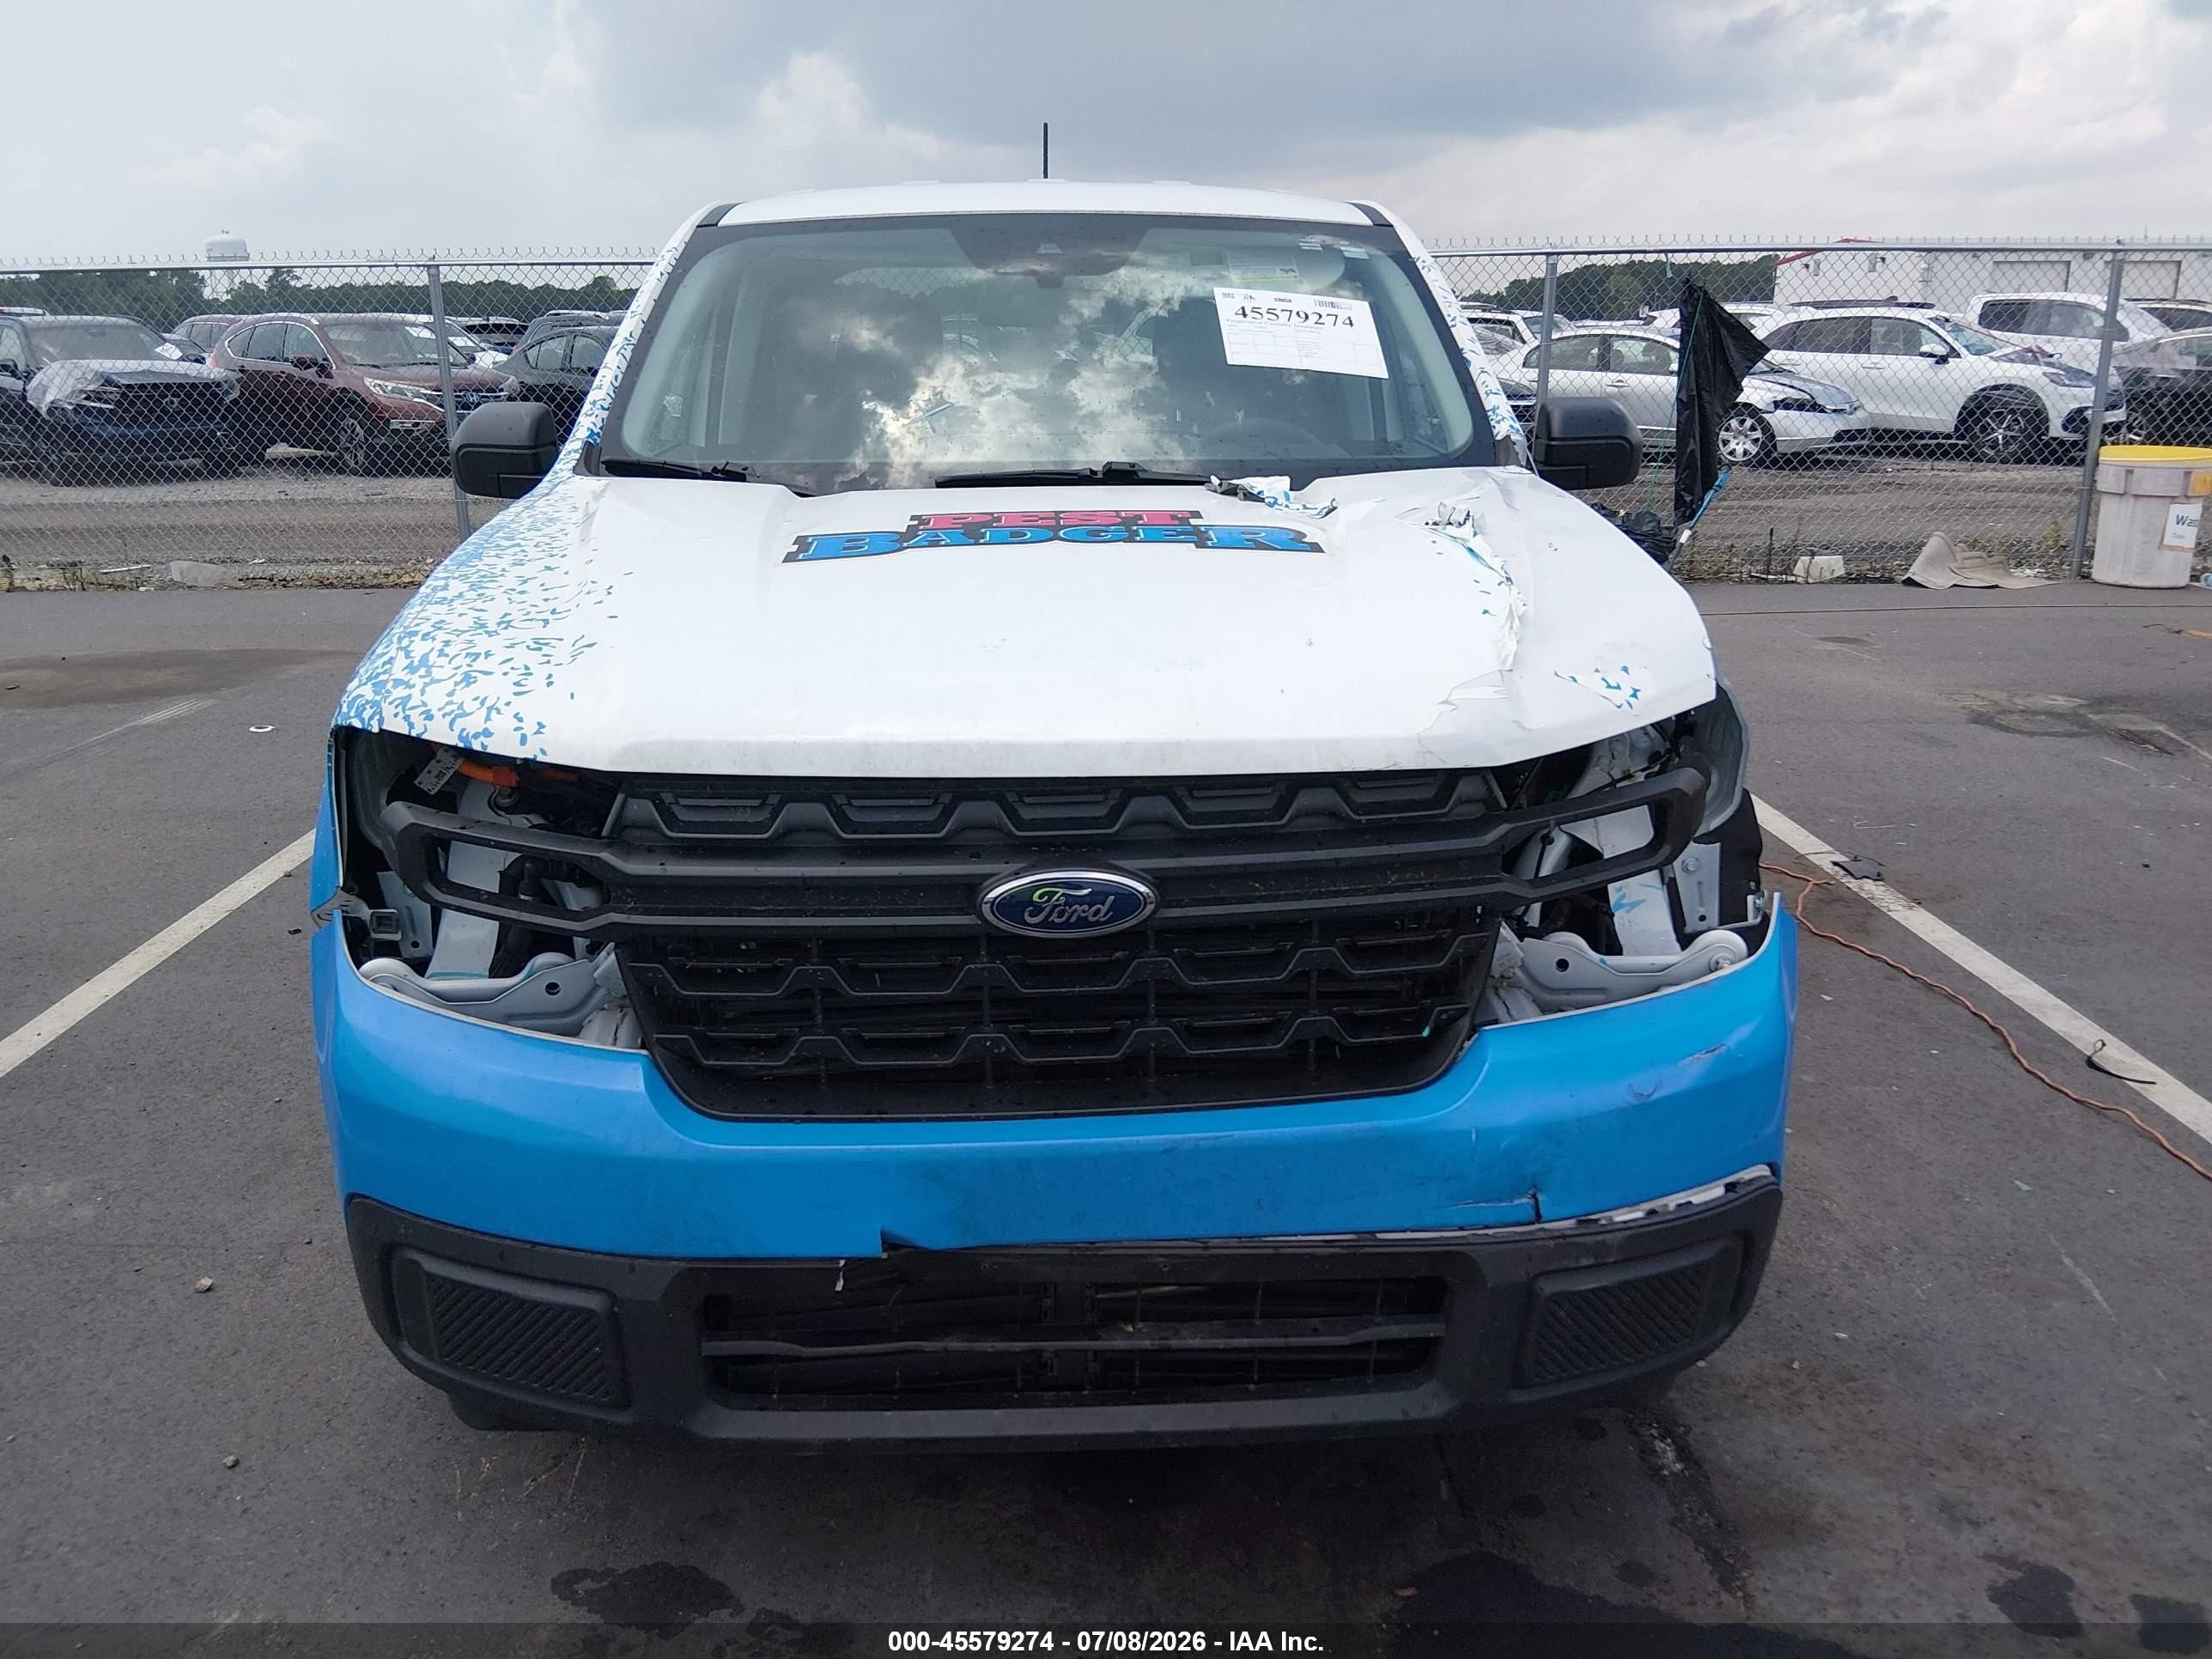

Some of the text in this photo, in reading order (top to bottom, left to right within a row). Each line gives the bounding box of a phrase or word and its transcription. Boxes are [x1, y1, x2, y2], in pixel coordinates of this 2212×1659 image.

[1234, 305, 1354, 329] 45579274
[915, 511, 1194, 530] PEST
[793, 524, 1314, 560] BADGER
[1024, 887, 1115, 925] Ford
